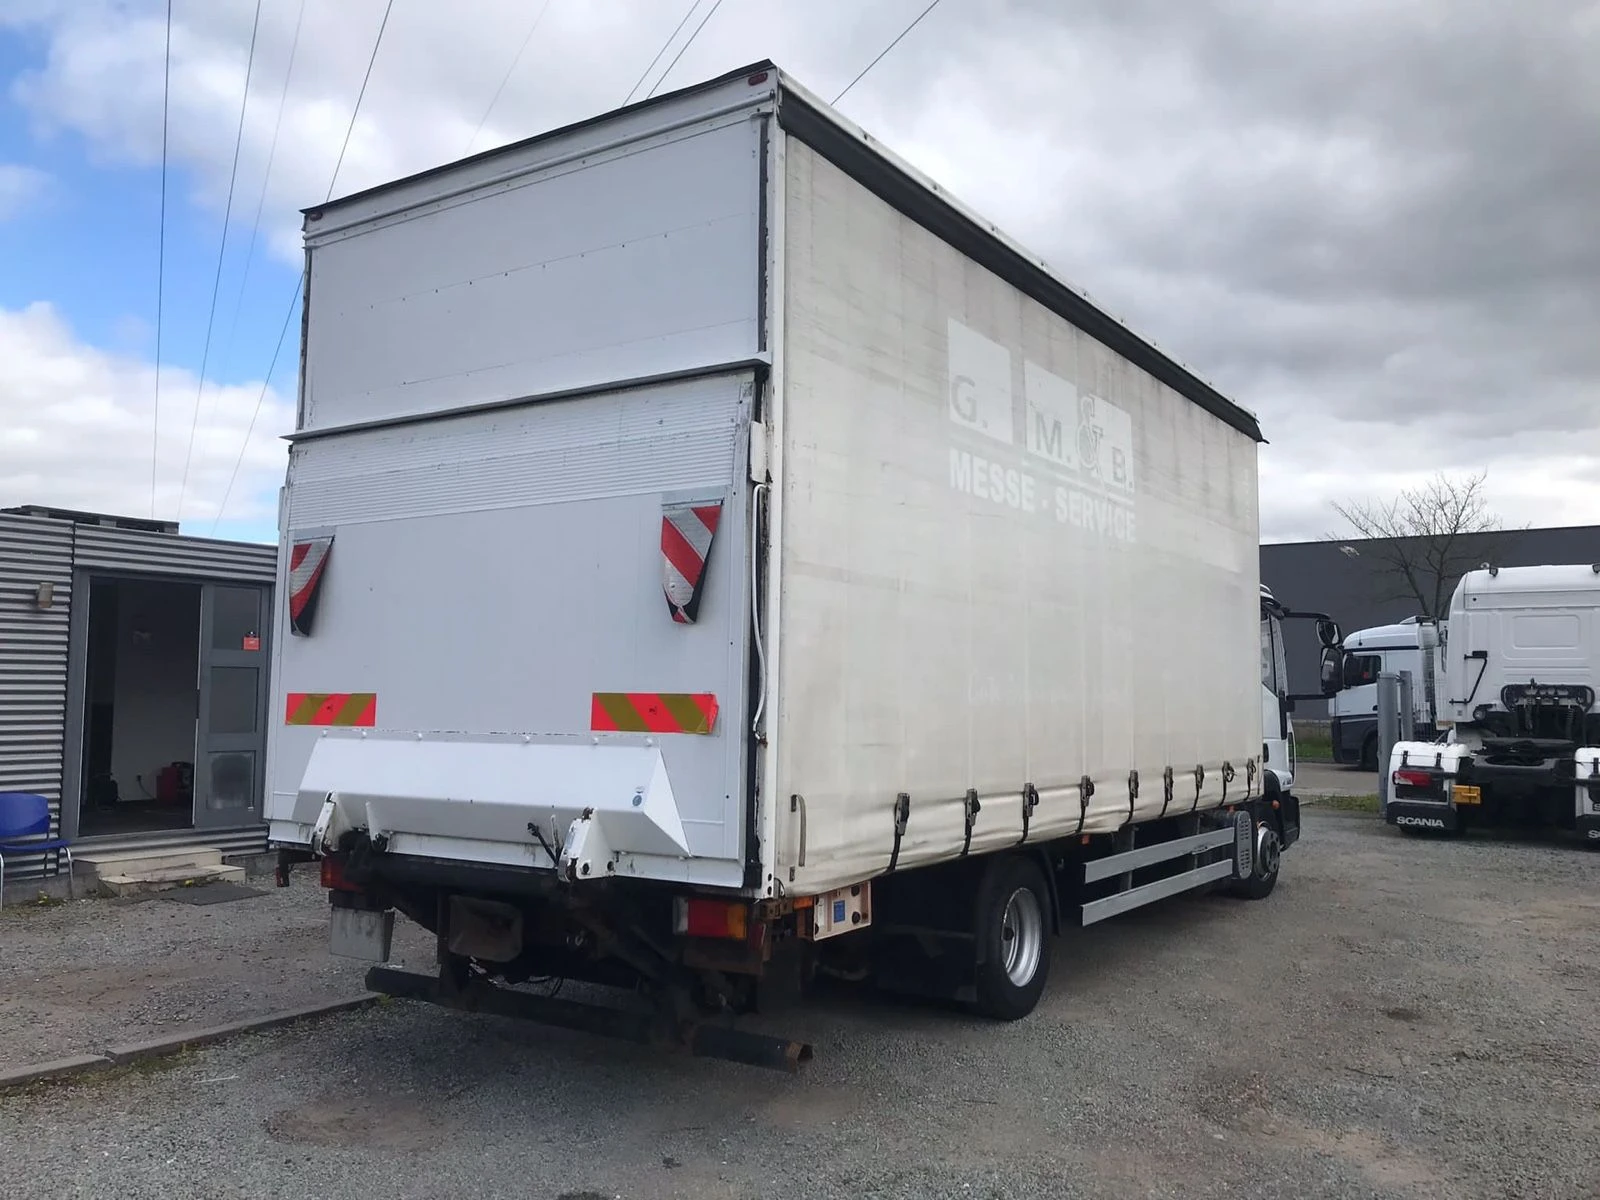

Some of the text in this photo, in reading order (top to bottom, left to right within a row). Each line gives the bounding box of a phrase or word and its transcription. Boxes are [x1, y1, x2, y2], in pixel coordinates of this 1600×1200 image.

[951, 374, 988, 429] G.
[1035, 411, 1071, 464] M.
[950, 448, 1036, 514] MESSE
[1055, 486, 1137, 544] SERVICE
[1396, 816, 1445, 828] SCANIA
